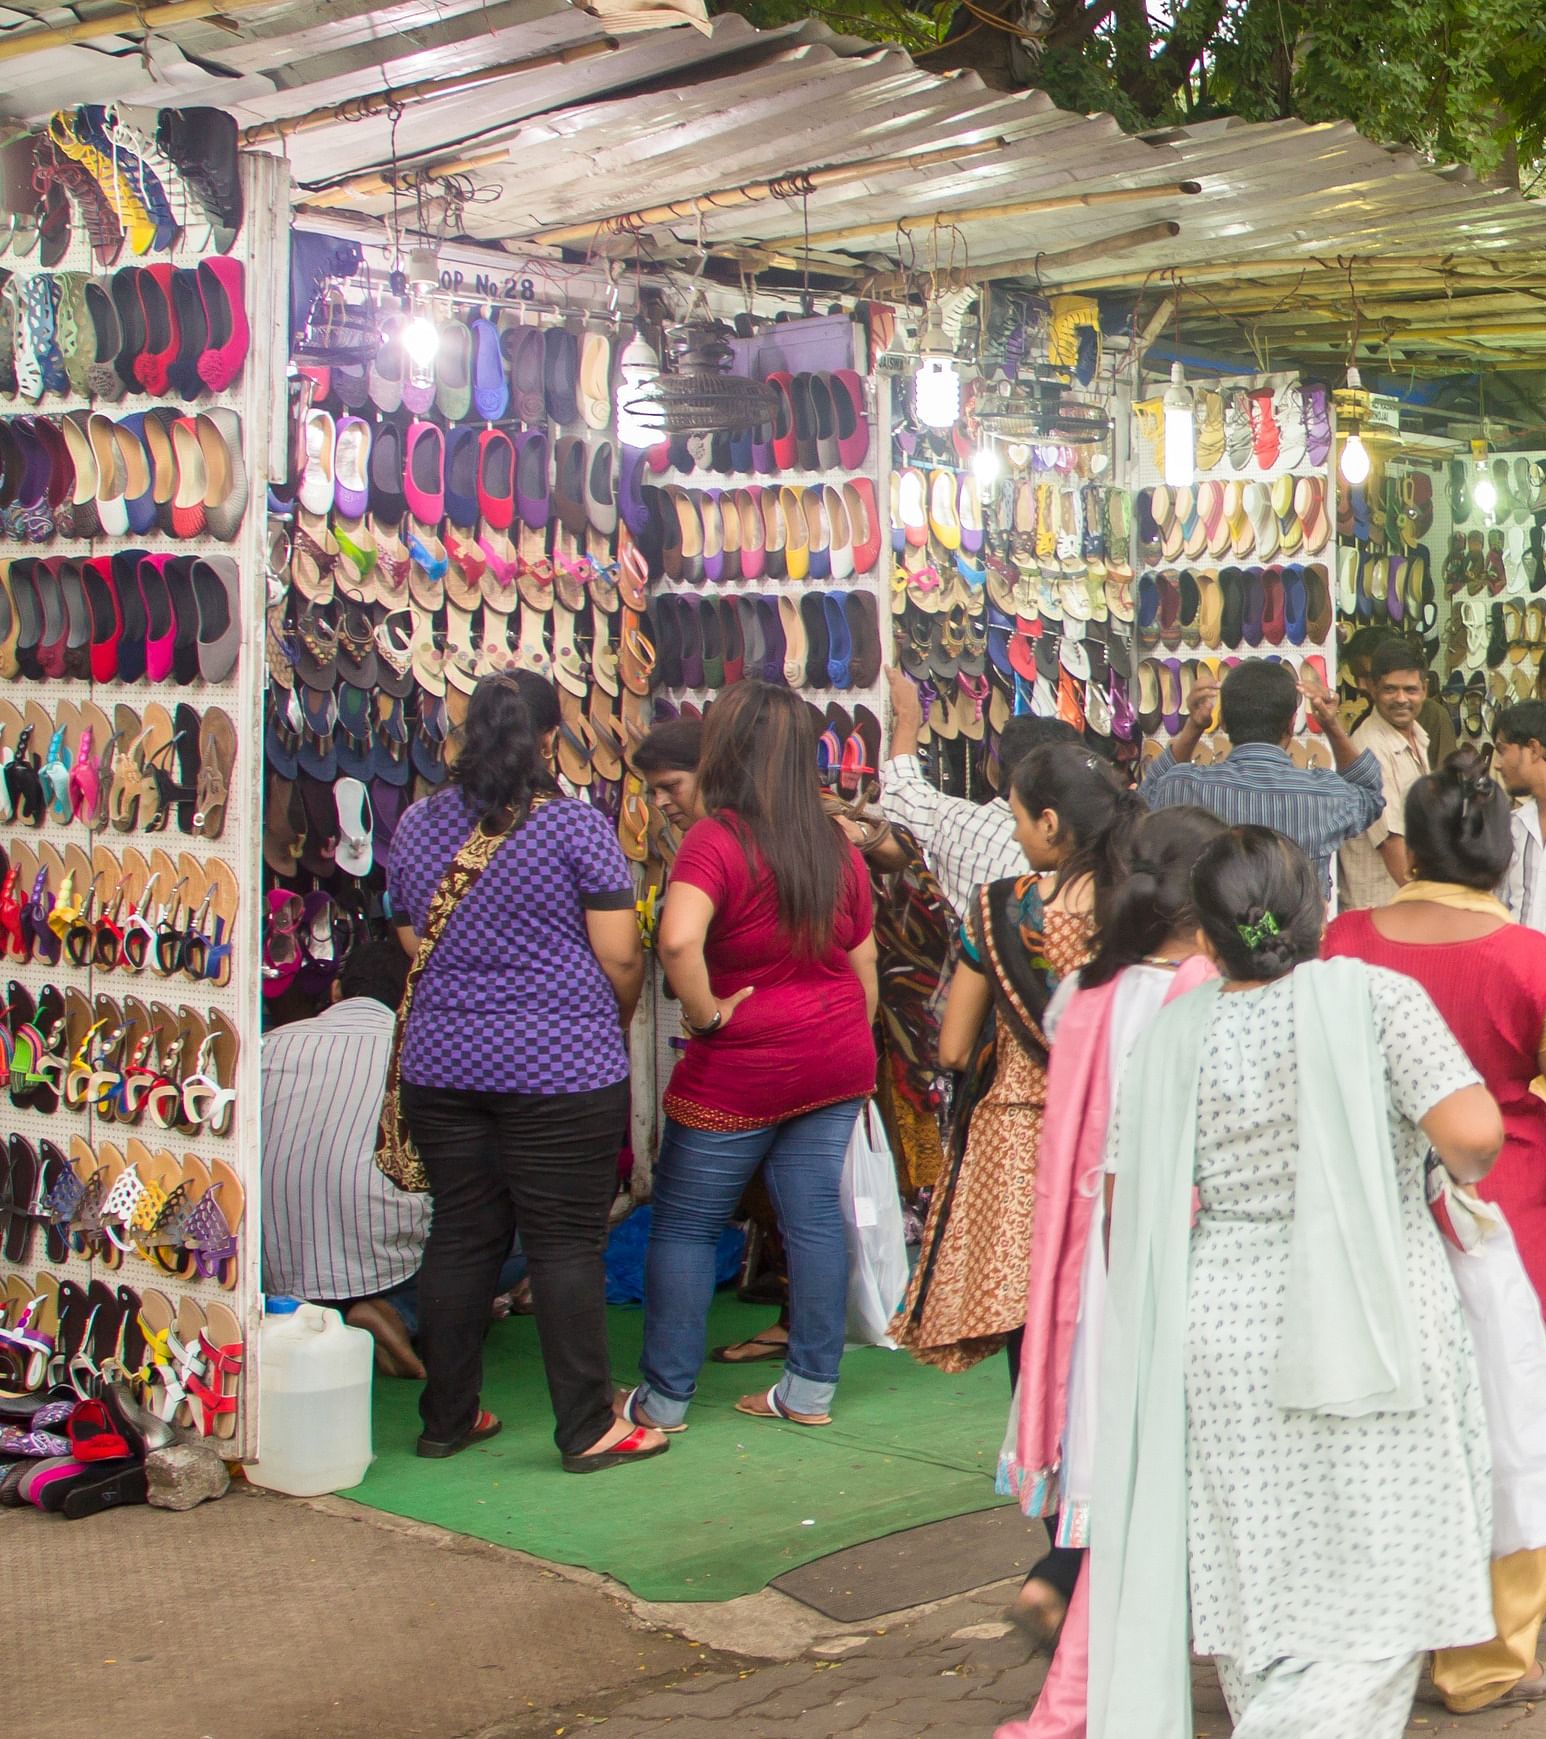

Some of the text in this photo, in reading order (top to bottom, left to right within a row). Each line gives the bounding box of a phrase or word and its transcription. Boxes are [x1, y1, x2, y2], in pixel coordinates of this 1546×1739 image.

[441, 270, 535, 300] OP No 28
